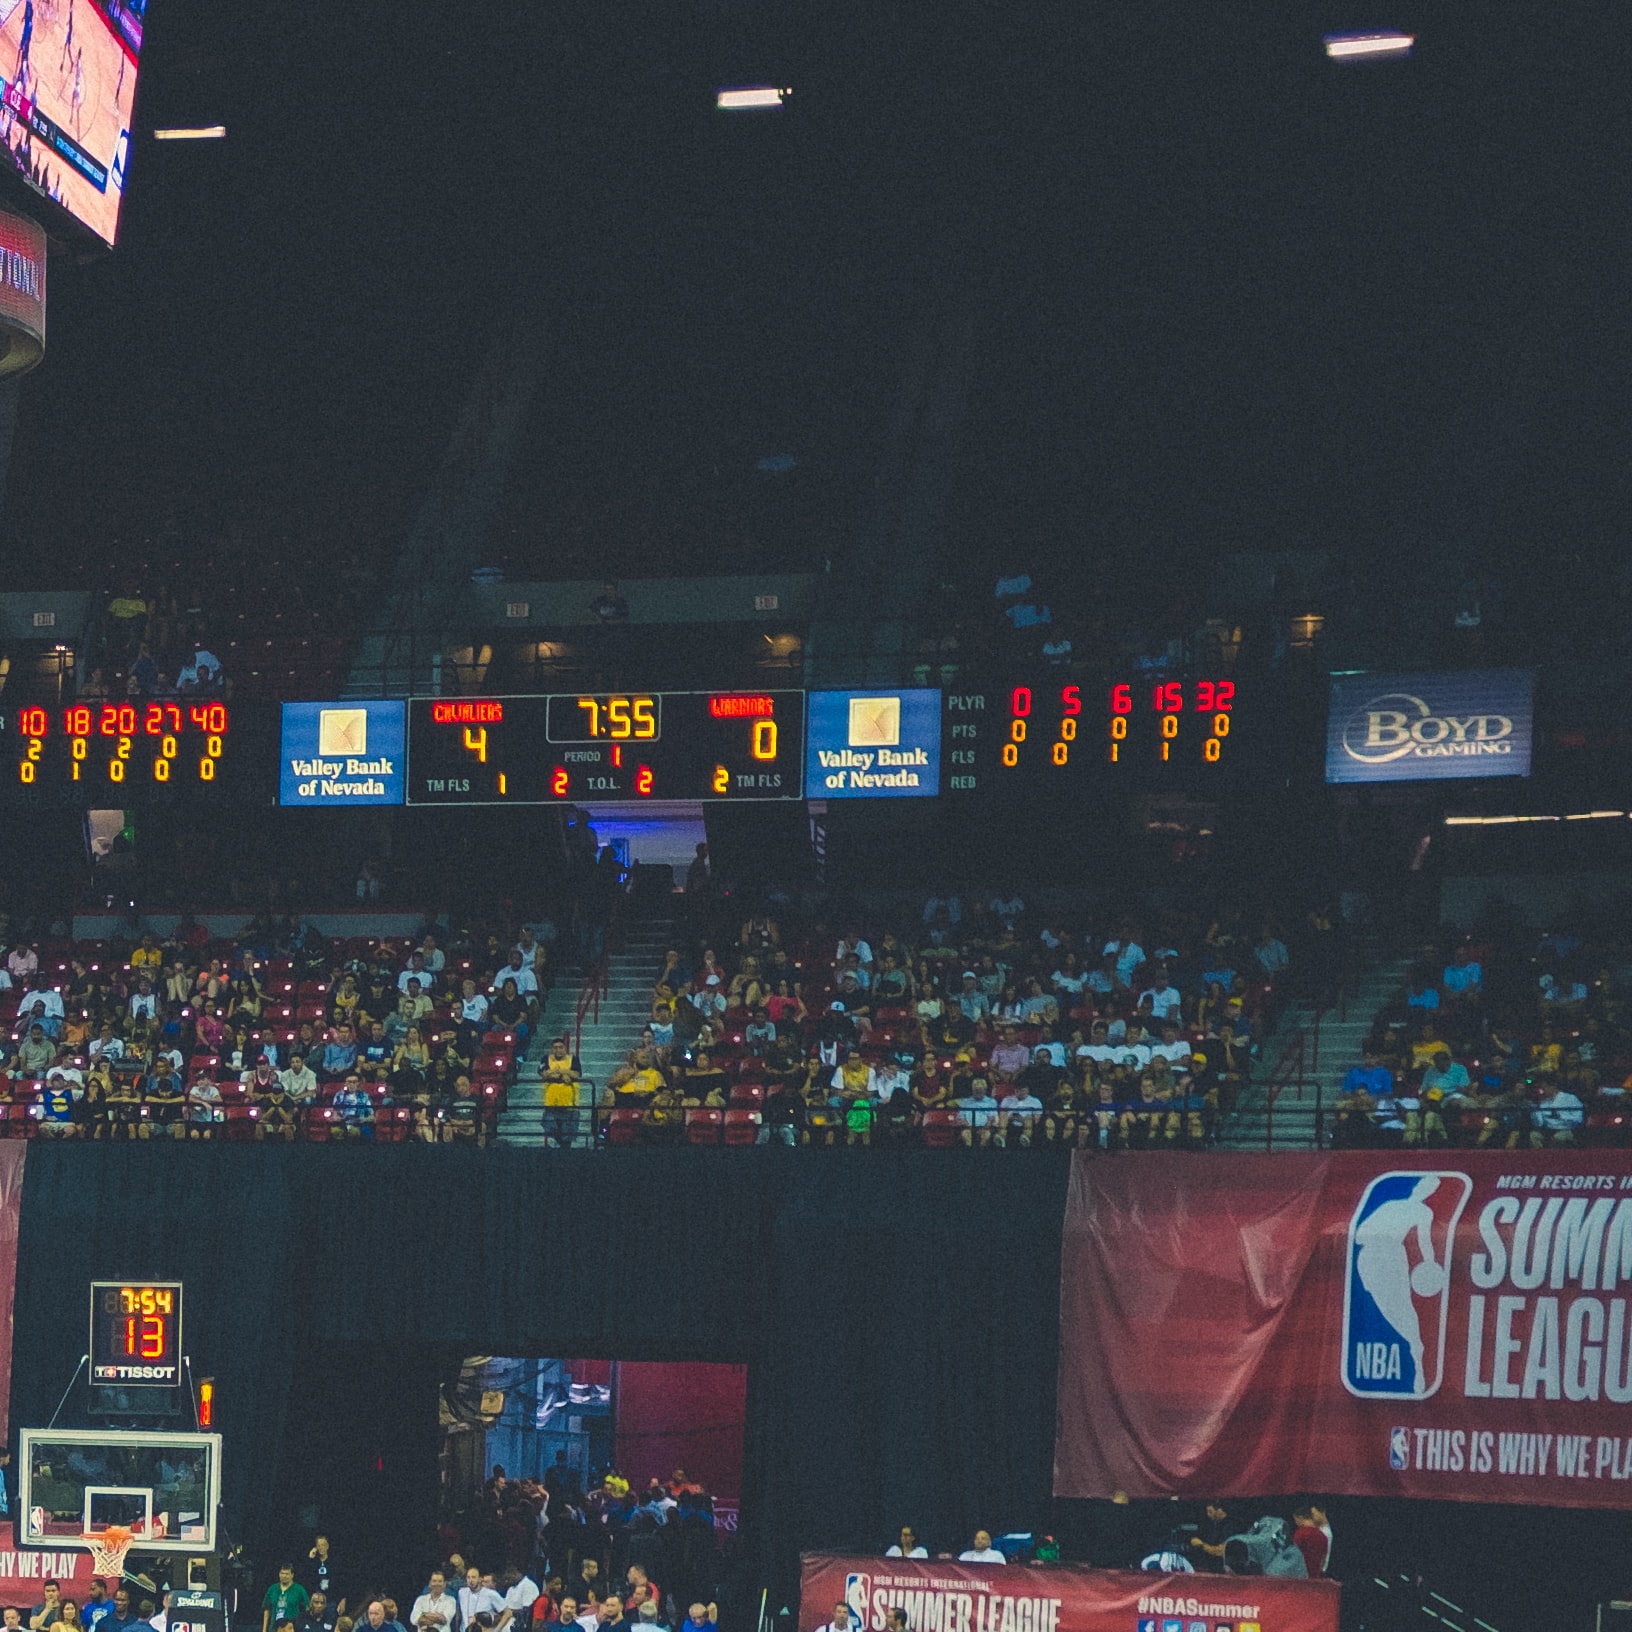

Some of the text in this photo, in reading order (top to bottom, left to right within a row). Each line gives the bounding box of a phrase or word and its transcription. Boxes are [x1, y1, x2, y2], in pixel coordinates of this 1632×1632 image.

[948, 681, 1235, 717] PLYR 0 5 6 15 32
[20, 708, 46, 736] 10
[66, 707, 91, 735] 18
[101, 708, 135, 735] 20
[146, 706, 182, 734] 27
[191, 706, 226, 733] 40
[578, 697, 656, 738] 7:55
[952, 713, 1229, 743] PTS 0 0 0 0 0
[28, 738, 42, 761] 2
[73, 737, 86, 759] 0
[117, 737, 131, 759] 2
[163, 735, 176, 758] 0
[208, 735, 222, 758] 0
[464, 726, 487, 763] 4
[754, 720, 777, 760] 0
[952, 738, 1220, 767] FLS 0 0 0
[1413, 741, 1512, 758] GAMING
[291, 759, 393, 778] Valley Bank
[564, 743, 621, 768] PERIOD 1
[818, 748, 928, 770] Valley Bank
[21, 761, 34, 783] 0
[111, 760, 124, 782] 0
[156, 759, 169, 781] 0
[200, 759, 214, 780] 0
[427, 780, 444, 793] TM
[448, 779, 470, 793] FLS
[498, 772, 506, 795] 1
[553, 767, 568, 796] 2
[637, 765, 653, 795] 2
[714, 764, 729, 794] 2
[736, 774, 755, 788] TM
[758, 774, 782, 788] FLS
[825, 769, 920, 790] of Nevada
[951, 776, 976, 789] REB
[298, 779, 384, 797] of Nevada
[1496, 1175, 1536, 1190] MGM
[1540, 1175, 1614, 1190] RESORTS
[121, 1288, 172, 1314] 7:54
[125, 1315, 164, 1359] 13
[116, 1365, 175, 1379] TISSOT
[1355, 1341, 1402, 1381] NBA
[1414, 1427, 1591, 1479] THIS IS WHY WE
[18, 1552, 40, 1578] WE
[42, 1552, 78, 1580] PLAY
[1137, 1596, 1261, 1619] #NBASummer
